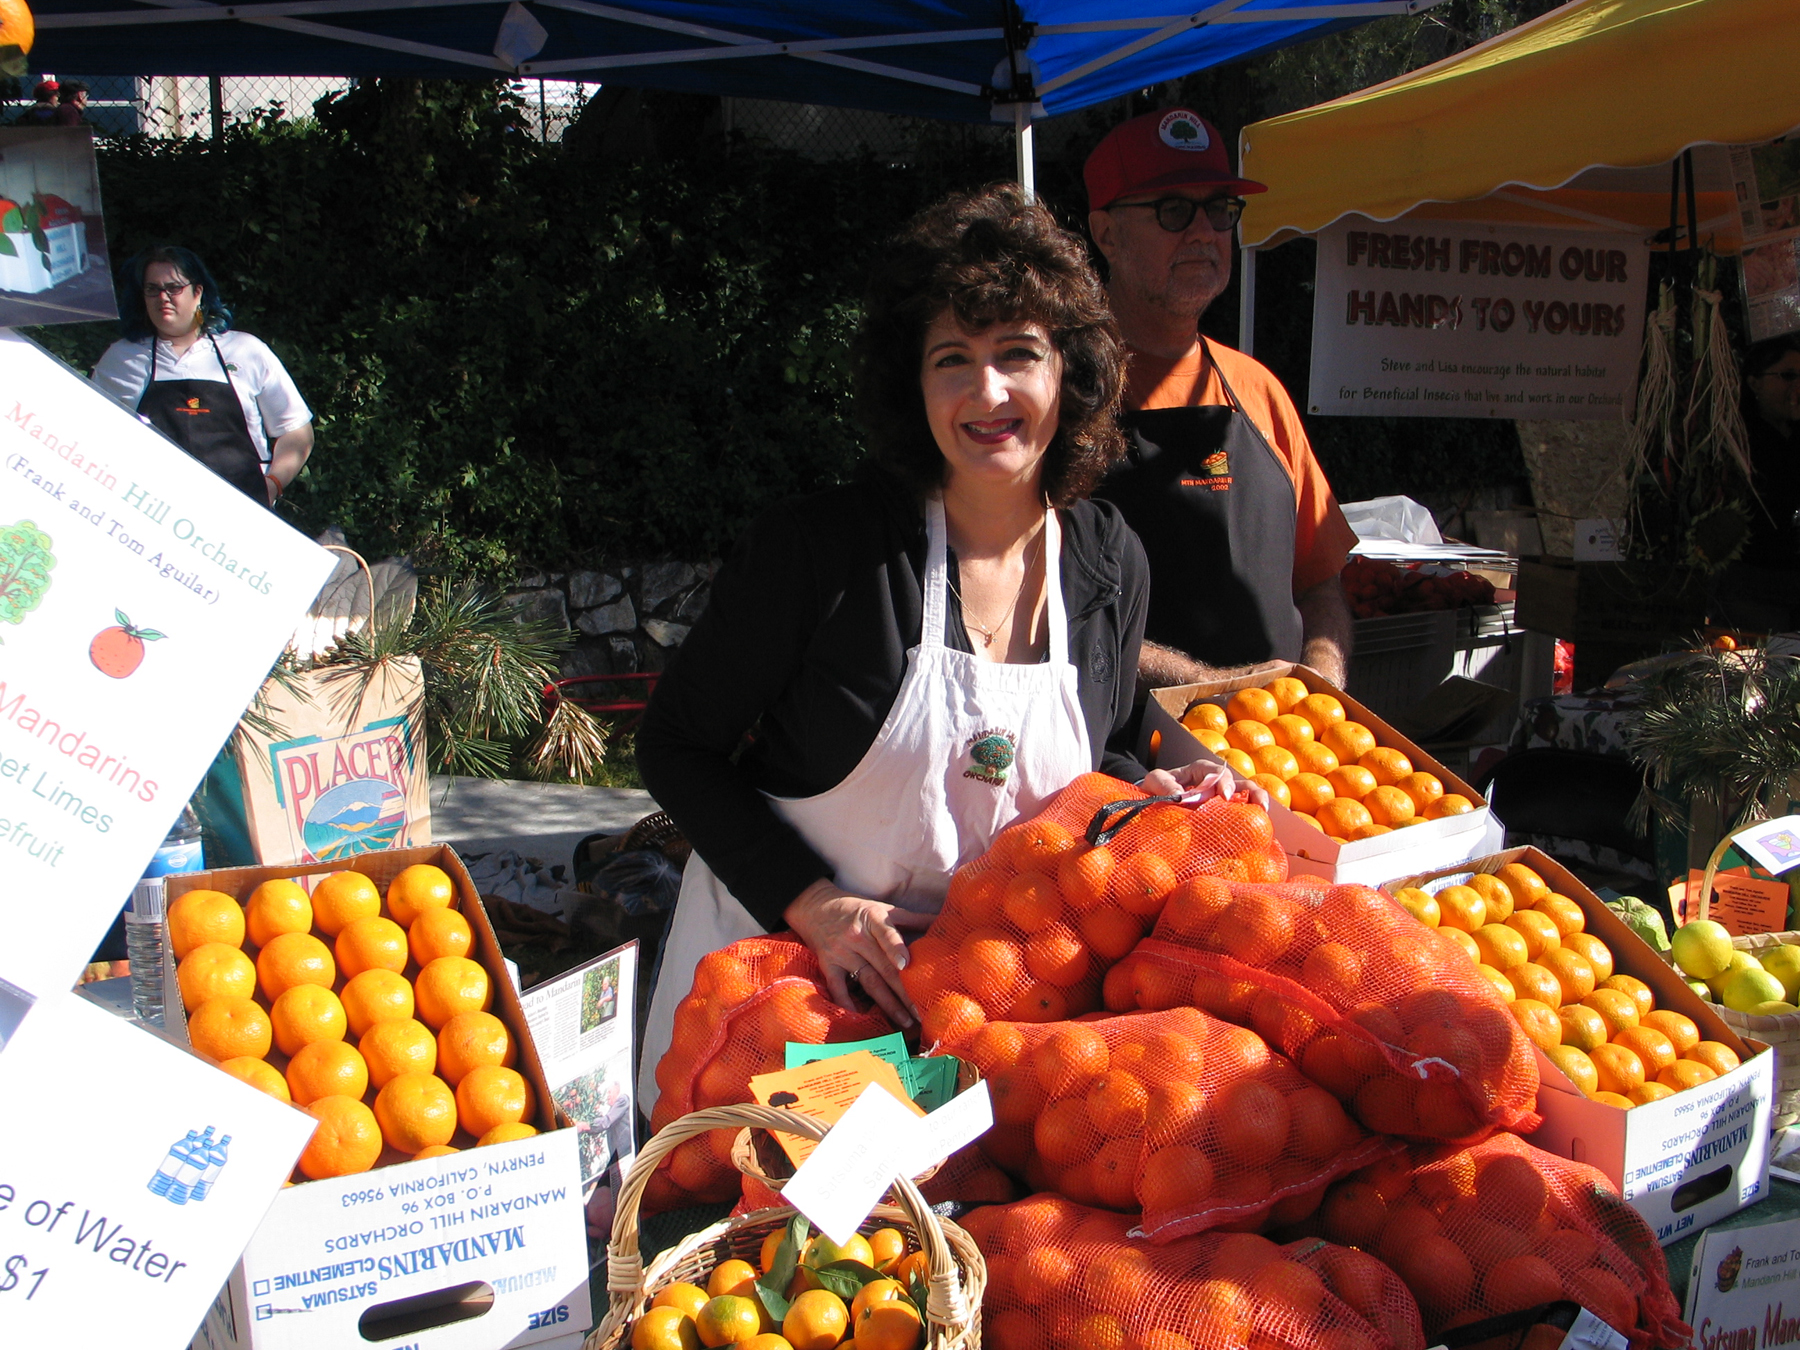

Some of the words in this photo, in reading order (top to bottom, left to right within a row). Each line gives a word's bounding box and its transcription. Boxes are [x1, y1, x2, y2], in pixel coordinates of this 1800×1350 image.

[1347, 231, 1452, 272] FRESH
[1459, 239, 1551, 279] FROM
[1559, 247, 1628, 283] OUR
[1346, 289, 1463, 331] HANDS
[1471, 297, 1516, 333] TO
[1522, 300, 1626, 338] YOURS
[1381, 357, 1411, 373] Steve
[1415, 359, 1435, 373] and
[1438, 360, 1458, 374] Lisa
[1461, 363, 1512, 380] encourage
[1515, 362, 1533, 377] the
[1535, 364, 1571, 378] natural
[1575, 365, 1607, 379] habitat
[1339, 386, 1357, 401] for
[1363, 386, 1419, 401] Beneficial
[1463, 388, 1483, 402] that
[1485, 389, 1500, 402] live
[1504, 390, 1524, 404] and
[1528, 391, 1552, 405] work
[1555, 392, 1566, 405] in
[1568, 395, 1585, 406] our
[4, 401, 117, 492] Mandarin
[121, 481, 175, 527] Hill
[172, 518, 274, 597] Orchards
[5, 452, 67, 502] (Frank
[69, 496, 106, 527] and
[105, 519, 145, 557] Tom
[147, 552, 221, 605] Aguilar)
[0, 681, 160, 803] Mandarins
[283, 735, 409, 812] PLACER
[32, 771, 114, 834] Limes
[545, 977, 581, 1001] Mandarin
[1674, 1101, 1696, 1118] 95663
[1696, 1083, 1737, 1108] CALIFORNIA
[1727, 1095, 1740, 1107] P.O.
[1699, 1110, 1709, 1121] 96
[1708, 1102, 1727, 1119] BOX
[1711, 1113, 1728, 1132] HILL
[1728, 1093, 1767, 1127] MANDARIN
[1661, 1124, 1710, 1152] ORCHARDS
[1683, 1123, 1749, 1170] MANDARINS
[484, 1151, 546, 1177] PENRYN,
[1635, 1153, 1684, 1181] CLEMENTINE
[389, 1166, 479, 1198] CALIFORNIA
[462, 1183, 493, 1201] P.O.
[1646, 1168, 1684, 1193] SATSUMA
[1741, 1180, 1761, 1201] SIZE
[341, 1187, 385, 1208] 95663
[402, 1200, 420, 1215] 96
[424, 1192, 456, 1211] BOX
[470, 1185, 568, 1222] MANDARIN
[432, 1210, 465, 1231] HILL
[1673, 1213, 1695, 1234] NET
[24, 1199, 76, 1233] of
[74, 1209, 188, 1284] Water
[324, 1220, 425, 1254] ORCHARDS
[378, 1224, 527, 1282] MANDARINS
[1745, 1255, 1770, 1270] Frank
[1771, 1251, 1788, 1264] and
[0, 1254, 50, 1301] $1
[273, 1256, 377, 1292] CLEMENTINE
[1741, 1271, 1781, 1290] Mandarin
[1782, 1267, 1798, 1283] Hill
[300, 1280, 378, 1311] SATSUMA
[528, 1303, 570, 1332] SIZE
[1699, 1316, 1757, 1350] Satsuma
